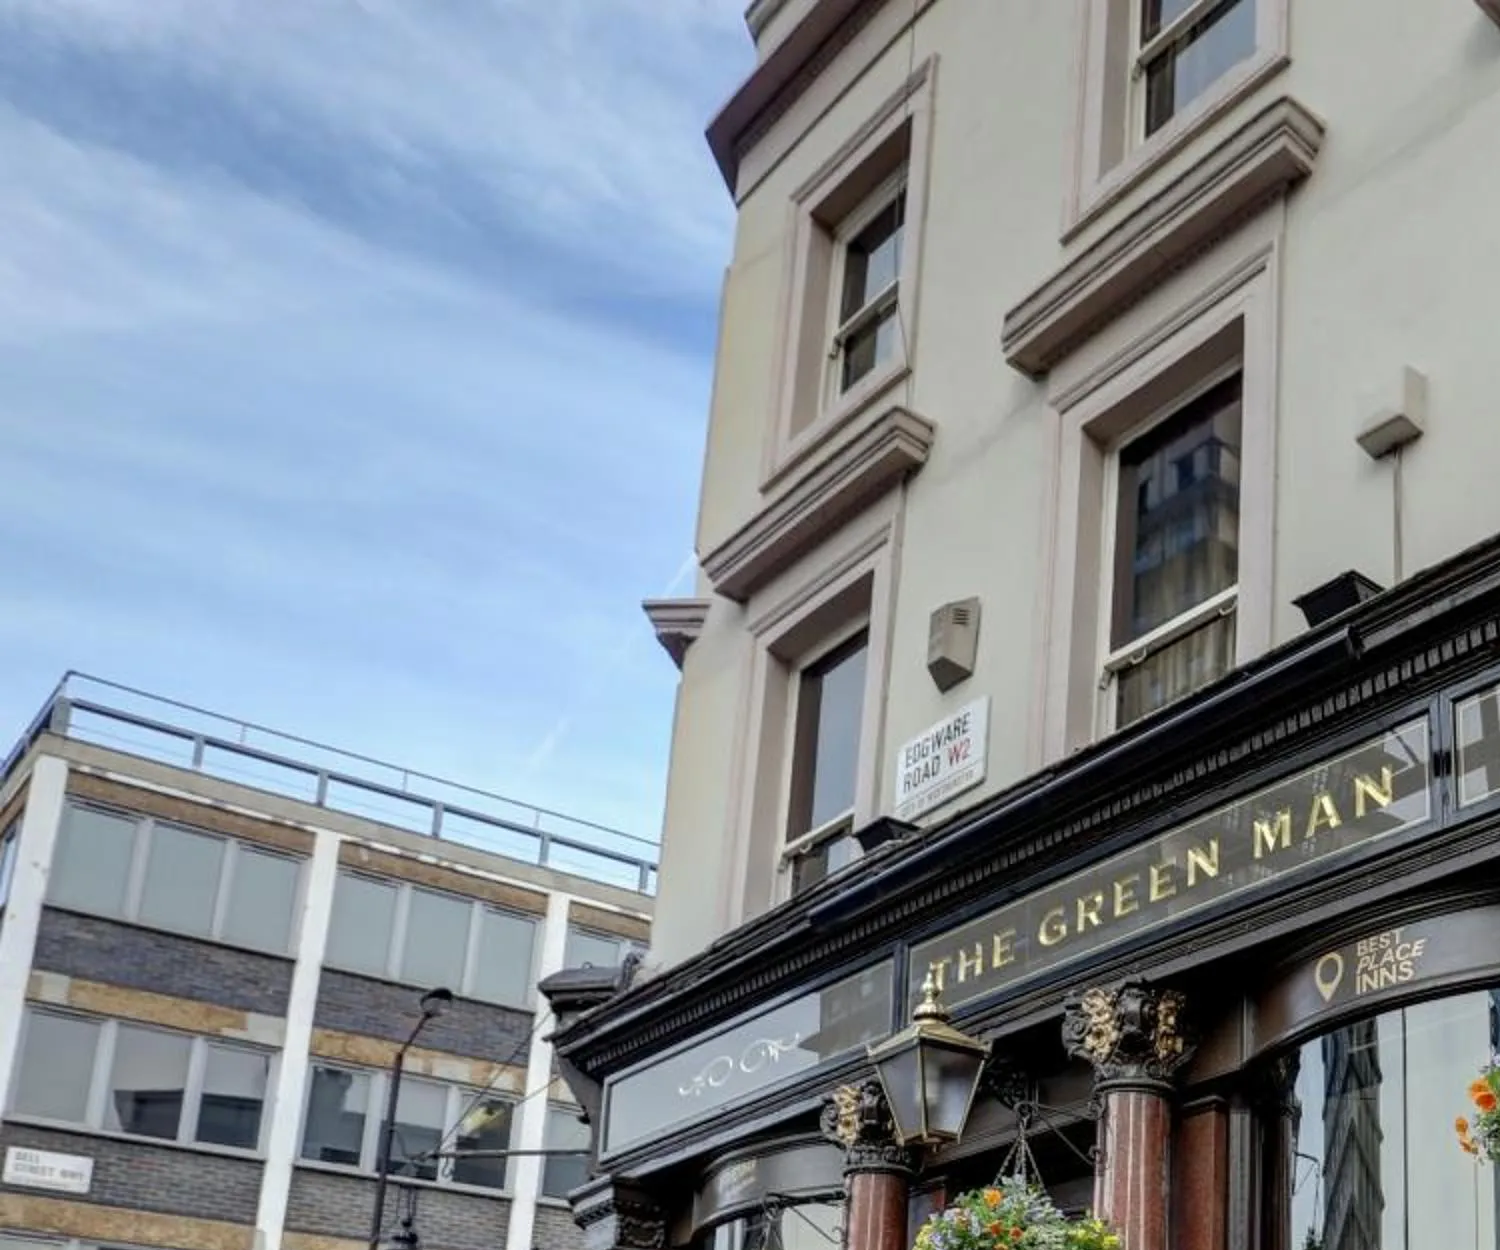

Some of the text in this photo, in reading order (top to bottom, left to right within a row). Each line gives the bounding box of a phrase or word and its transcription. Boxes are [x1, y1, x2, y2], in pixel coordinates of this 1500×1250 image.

[905, 711, 971, 768] EDGWARE
[903, 737, 971, 794] ROAD W2
[928, 763, 1394, 992] THE GREEN MAN
[1356, 938, 1428, 975] PLACE
[1357, 927, 1404, 957] BEST
[1356, 960, 1415, 995] INNS
